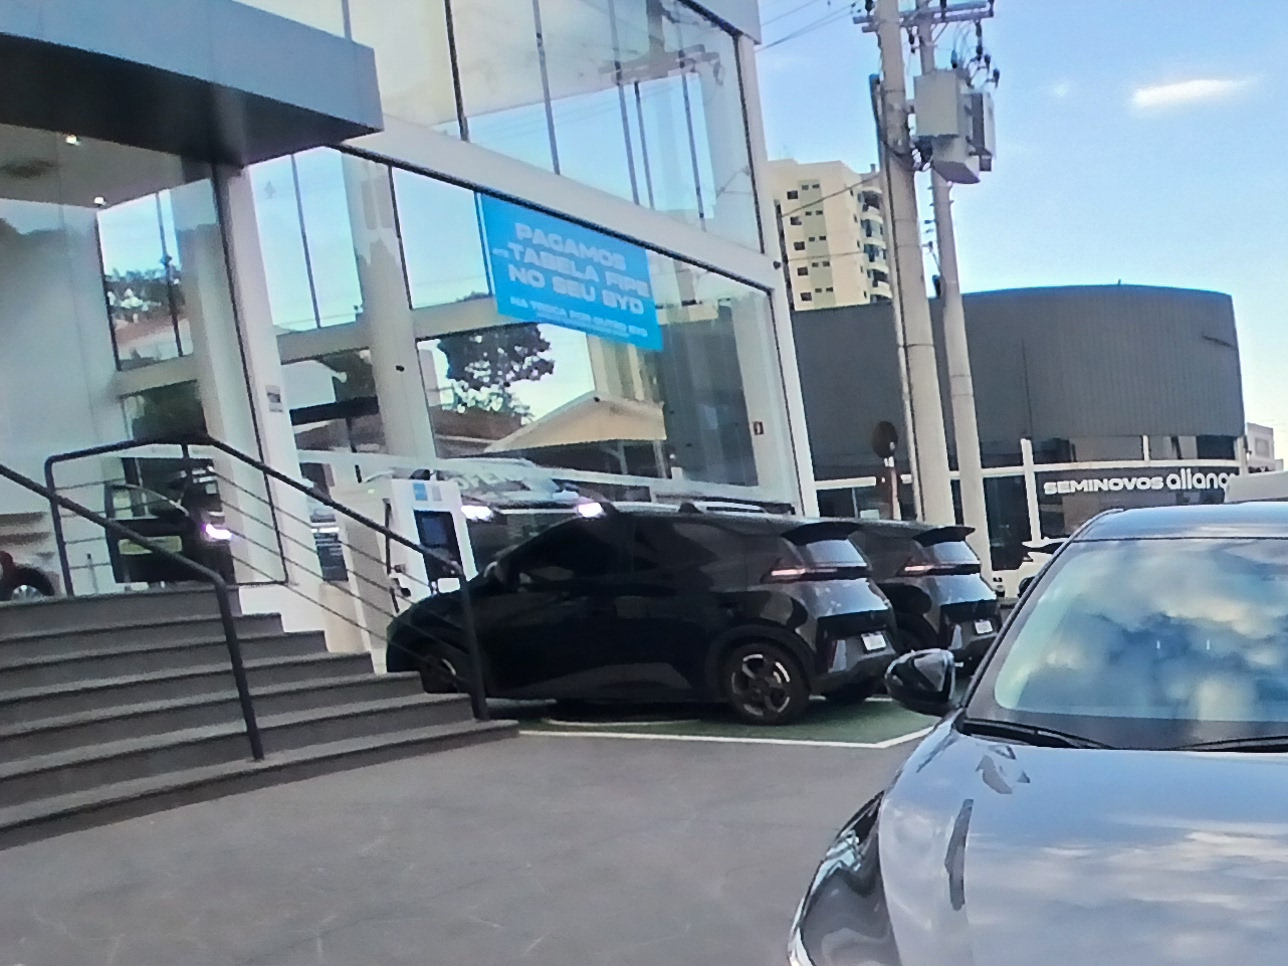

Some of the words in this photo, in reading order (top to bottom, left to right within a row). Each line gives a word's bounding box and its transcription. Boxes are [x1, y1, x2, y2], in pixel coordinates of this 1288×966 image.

[507, 242, 600, 283] TABELA
[604, 270, 650, 298] FIPE
[514, 222, 626, 271] PAGAMOS
[508, 264, 546, 288] NO
[552, 276, 596, 302] SEU
[602, 289, 644, 315] BYD
[1043, 476, 1164, 495] SEMINOVOS
